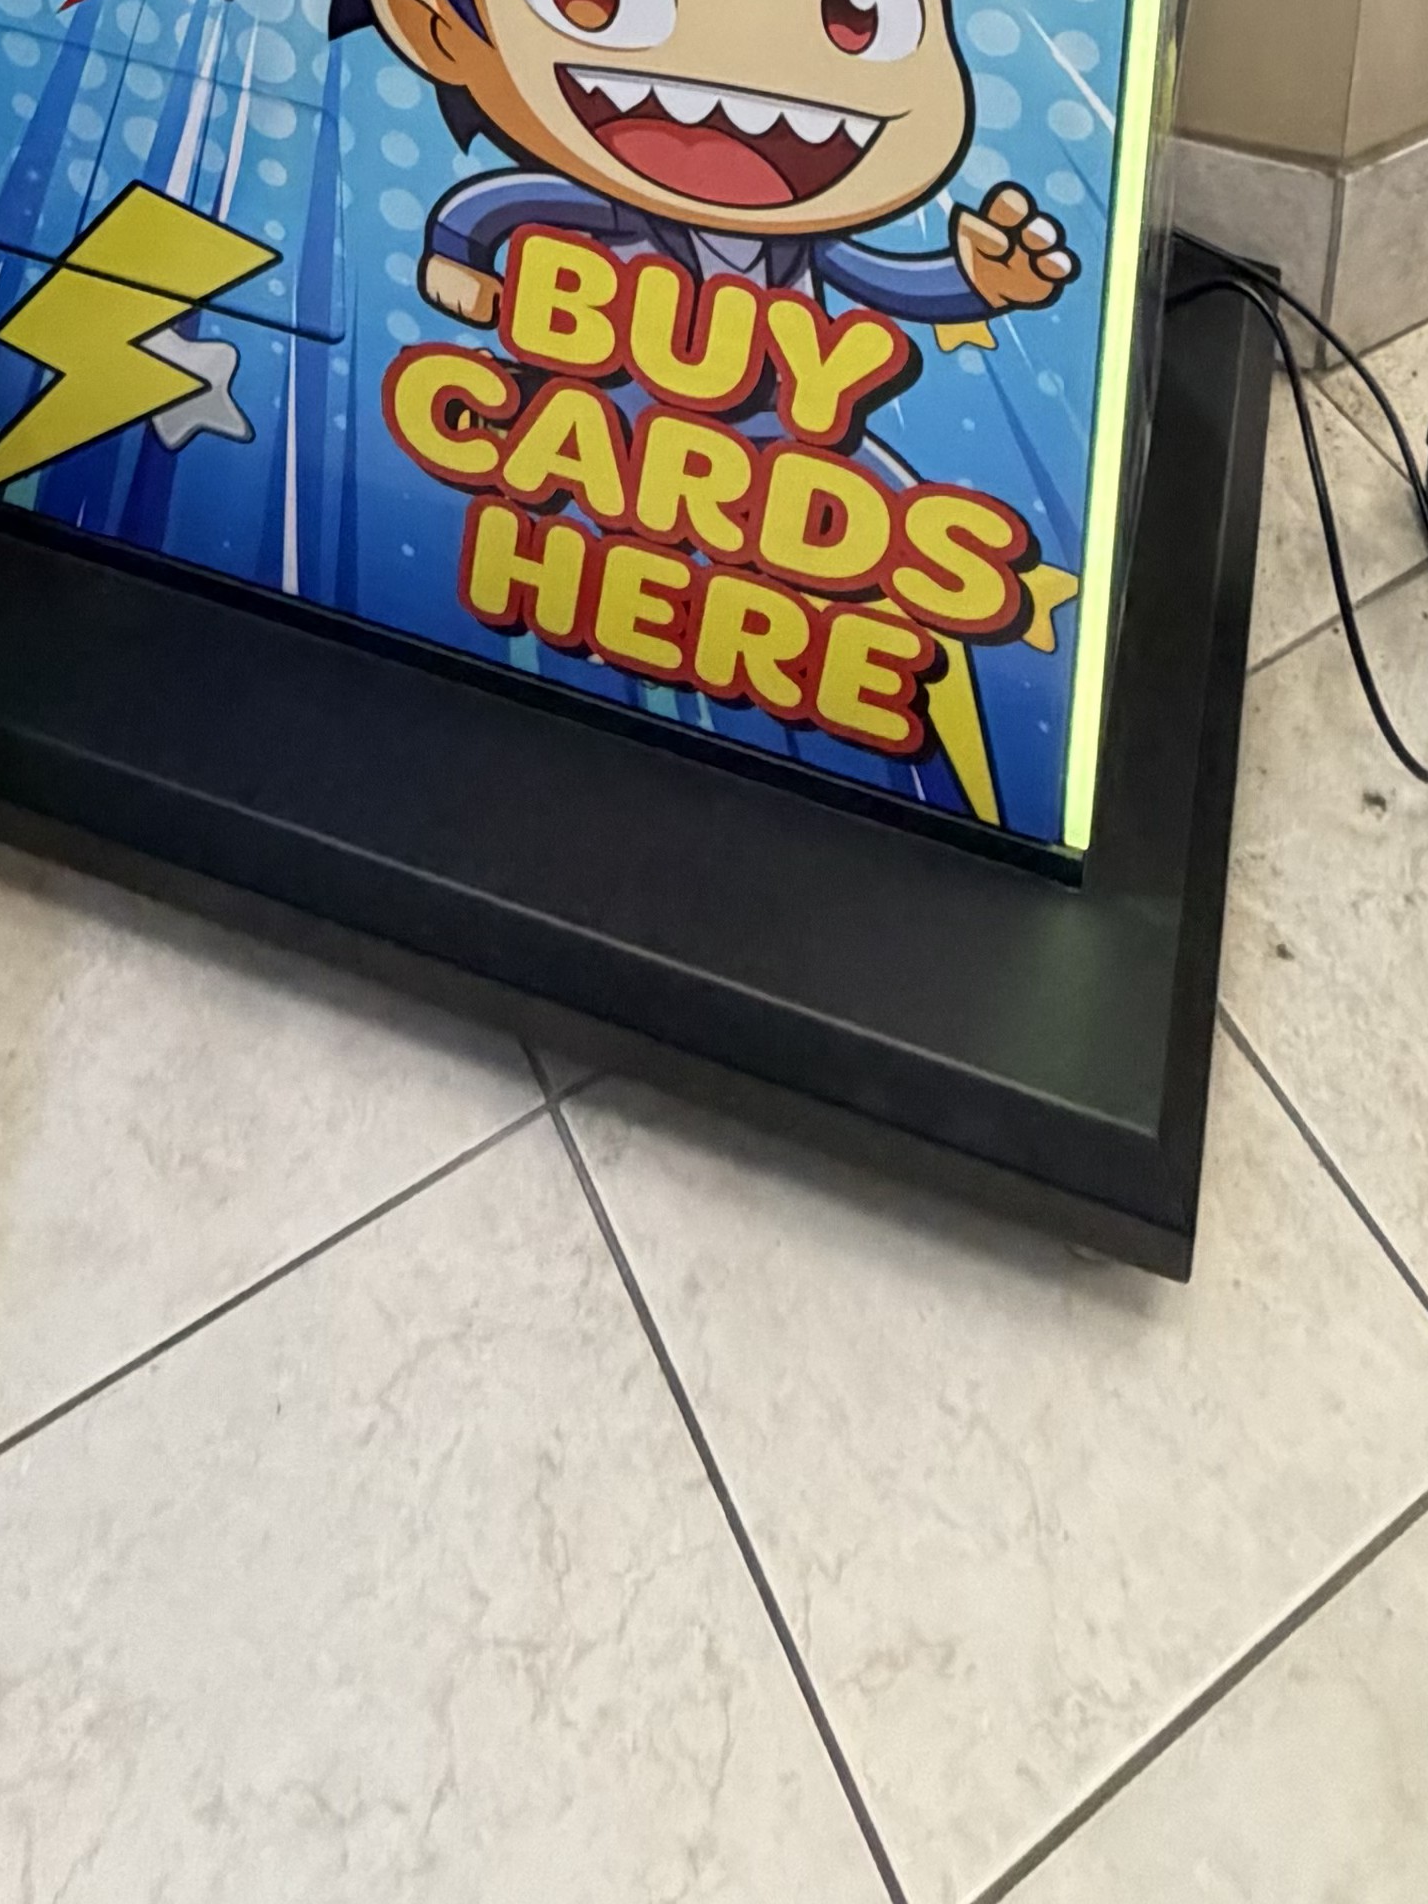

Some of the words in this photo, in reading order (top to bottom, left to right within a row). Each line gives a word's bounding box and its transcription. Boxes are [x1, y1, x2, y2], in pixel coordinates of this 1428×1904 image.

[506, 231, 897, 436] BUY
[390, 348, 1017, 624] CARDS
[467, 503, 925, 744] HERE
